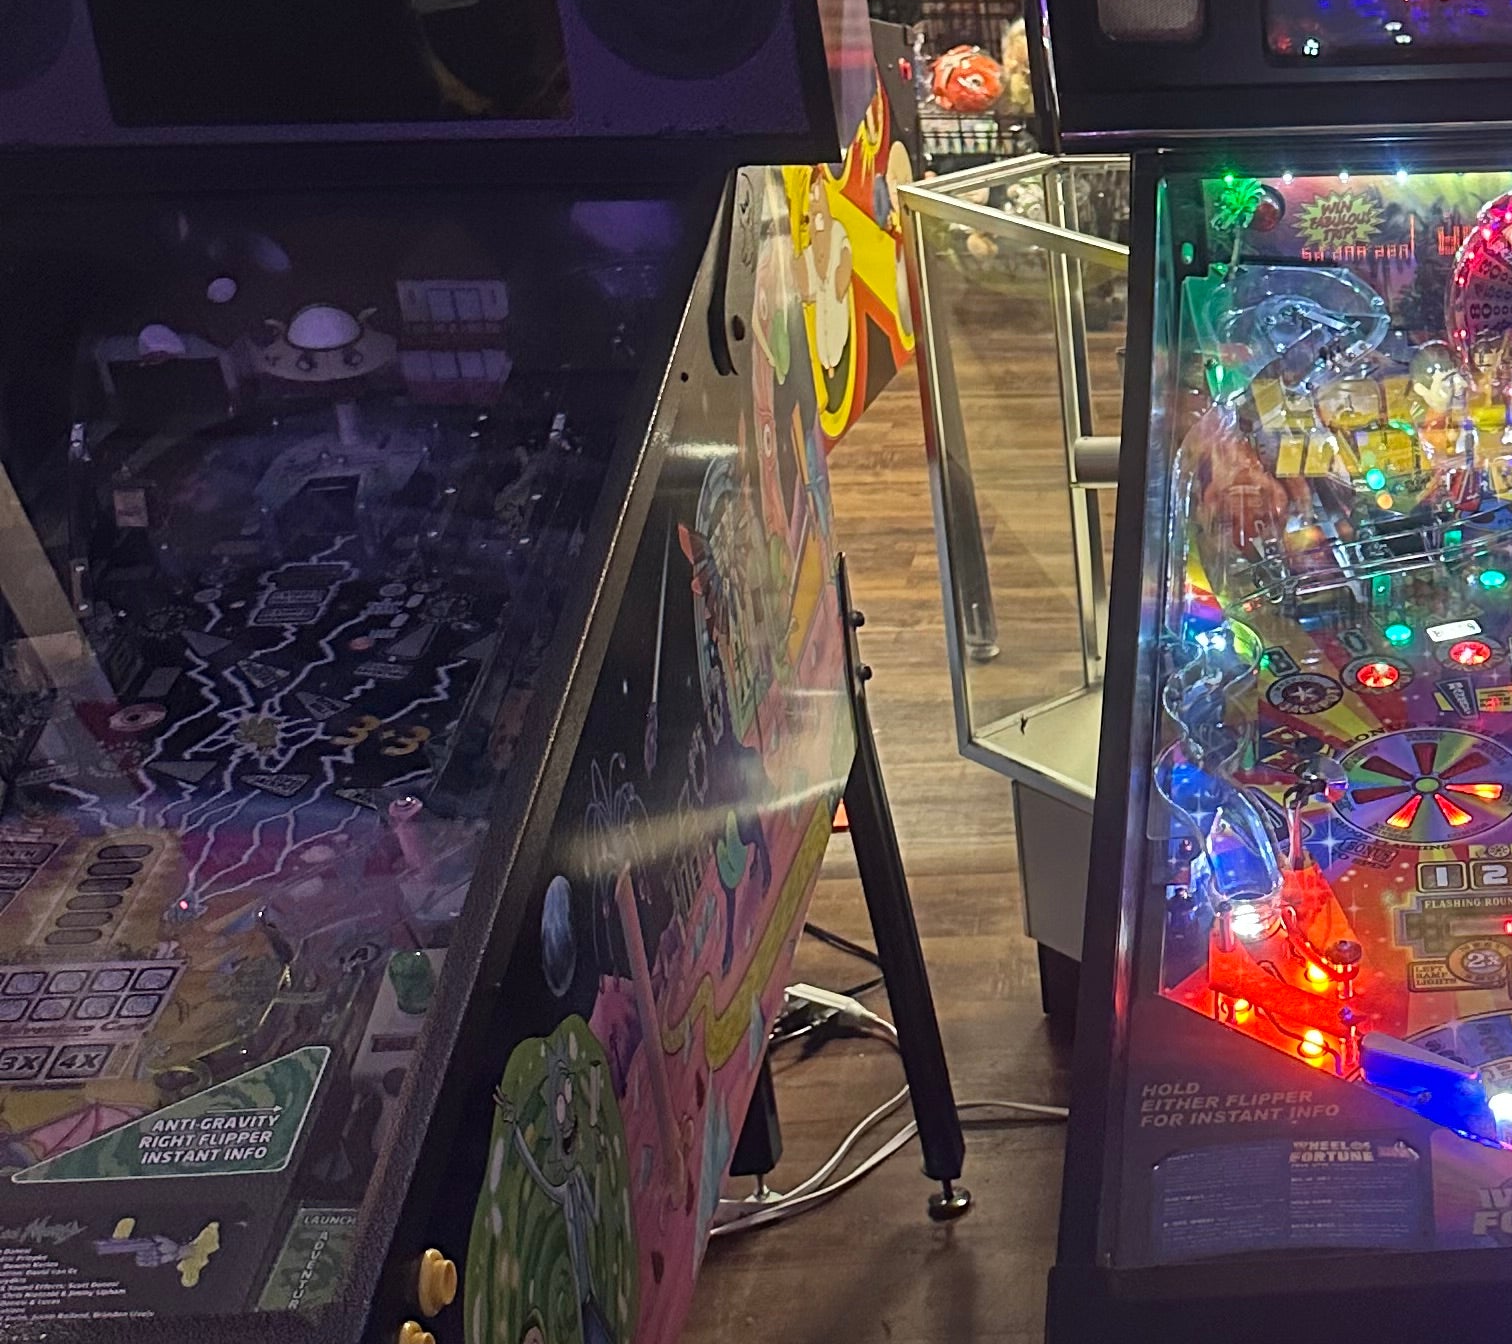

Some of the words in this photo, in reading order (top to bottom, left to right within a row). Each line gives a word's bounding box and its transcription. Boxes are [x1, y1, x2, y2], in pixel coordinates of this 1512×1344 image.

[1322, 200, 1353, 217] WIN
[1435, 866, 1448, 887] 1
[1482, 864, 1509, 885] 2
[1424, 897, 1482, 909] FLASHING
[59, 1054, 101, 1069] 4X
[1143, 1082, 1200, 1097] HOLD
[1141, 1096, 1219, 1112] EITHER
[1225, 1091, 1313, 1107] FLIPPER
[152, 1114, 280, 1133] ANTI-GRAVITY
[1140, 1113, 1183, 1128] FOR
[1190, 1108, 1281, 1125] INSTANT
[1290, 1104, 1340, 1119] INFO
[138, 1134, 196, 1149] RIGHT
[198, 1130, 273, 1147] FLIPPER
[141, 1148, 221, 1165] INSTANT
[224, 1146, 268, 1160] INFO
[1289, 1151, 1375, 1163] FORTUNE
[303, 1215, 356, 1225] LAUNCH
